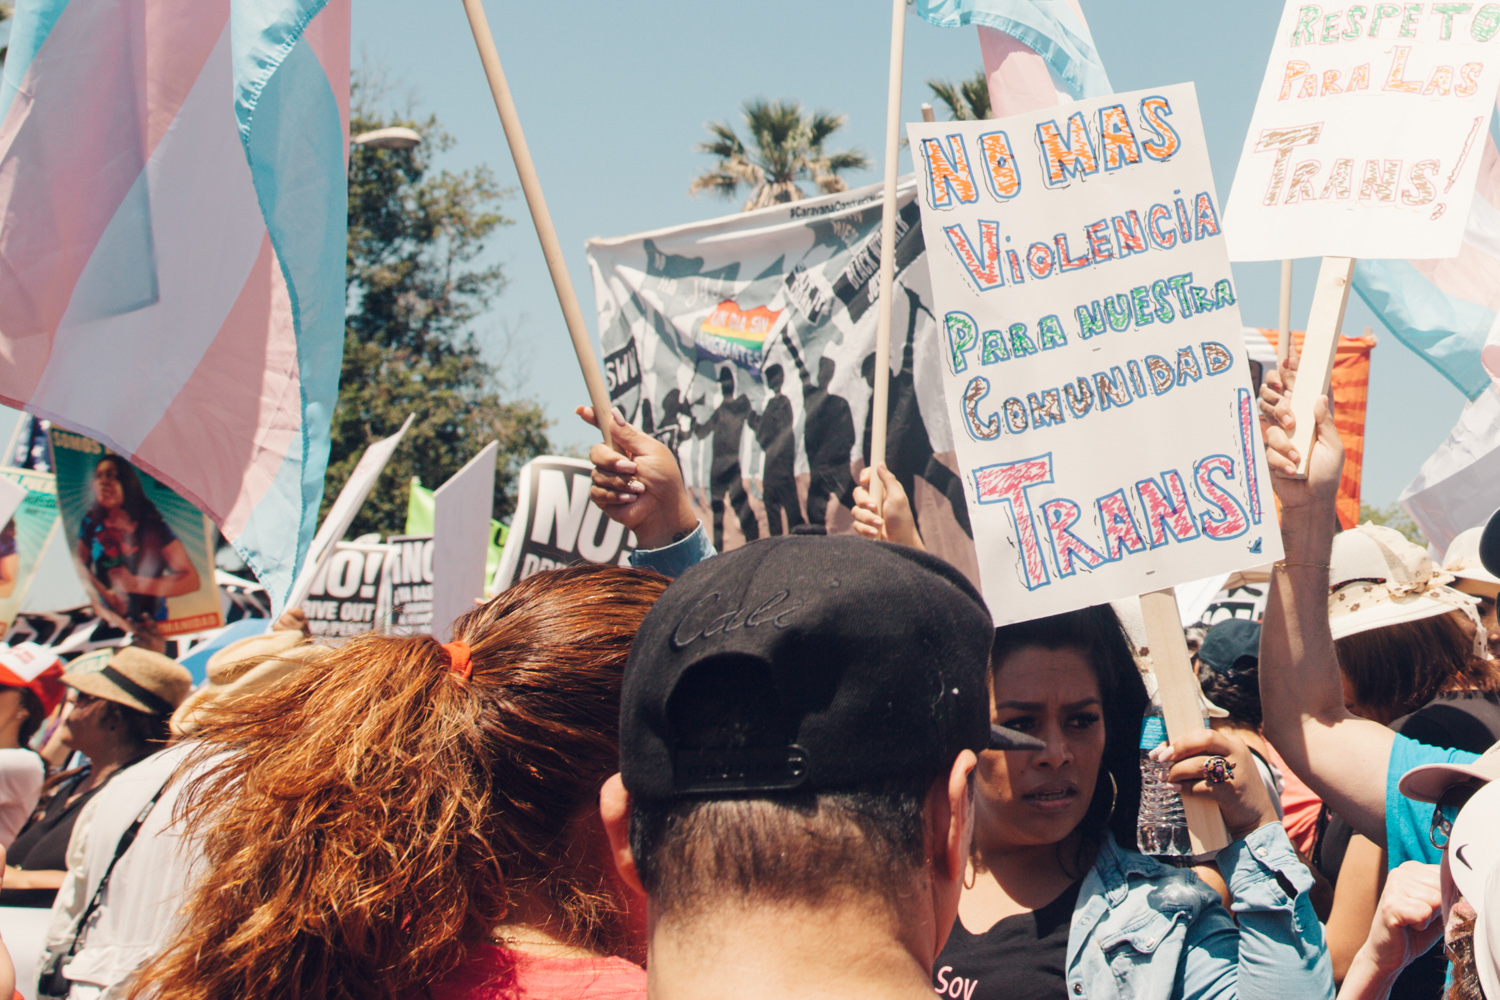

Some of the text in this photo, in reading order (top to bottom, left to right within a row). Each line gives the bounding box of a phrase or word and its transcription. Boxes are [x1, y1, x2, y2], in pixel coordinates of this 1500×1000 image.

[1279, 45, 1483, 101] PARA LAS
[921, 95, 1181, 209] NO MAS
[1254, 116, 1484, 220] TRANS!
[944, 272, 1238, 374] PARA NUESTRA
[962, 342, 1234, 441] COMUNIDAD
[972, 388, 1263, 591] TRANS!
[301, 600, 338, 619] RIVE
[341, 602, 376, 621] OUT
